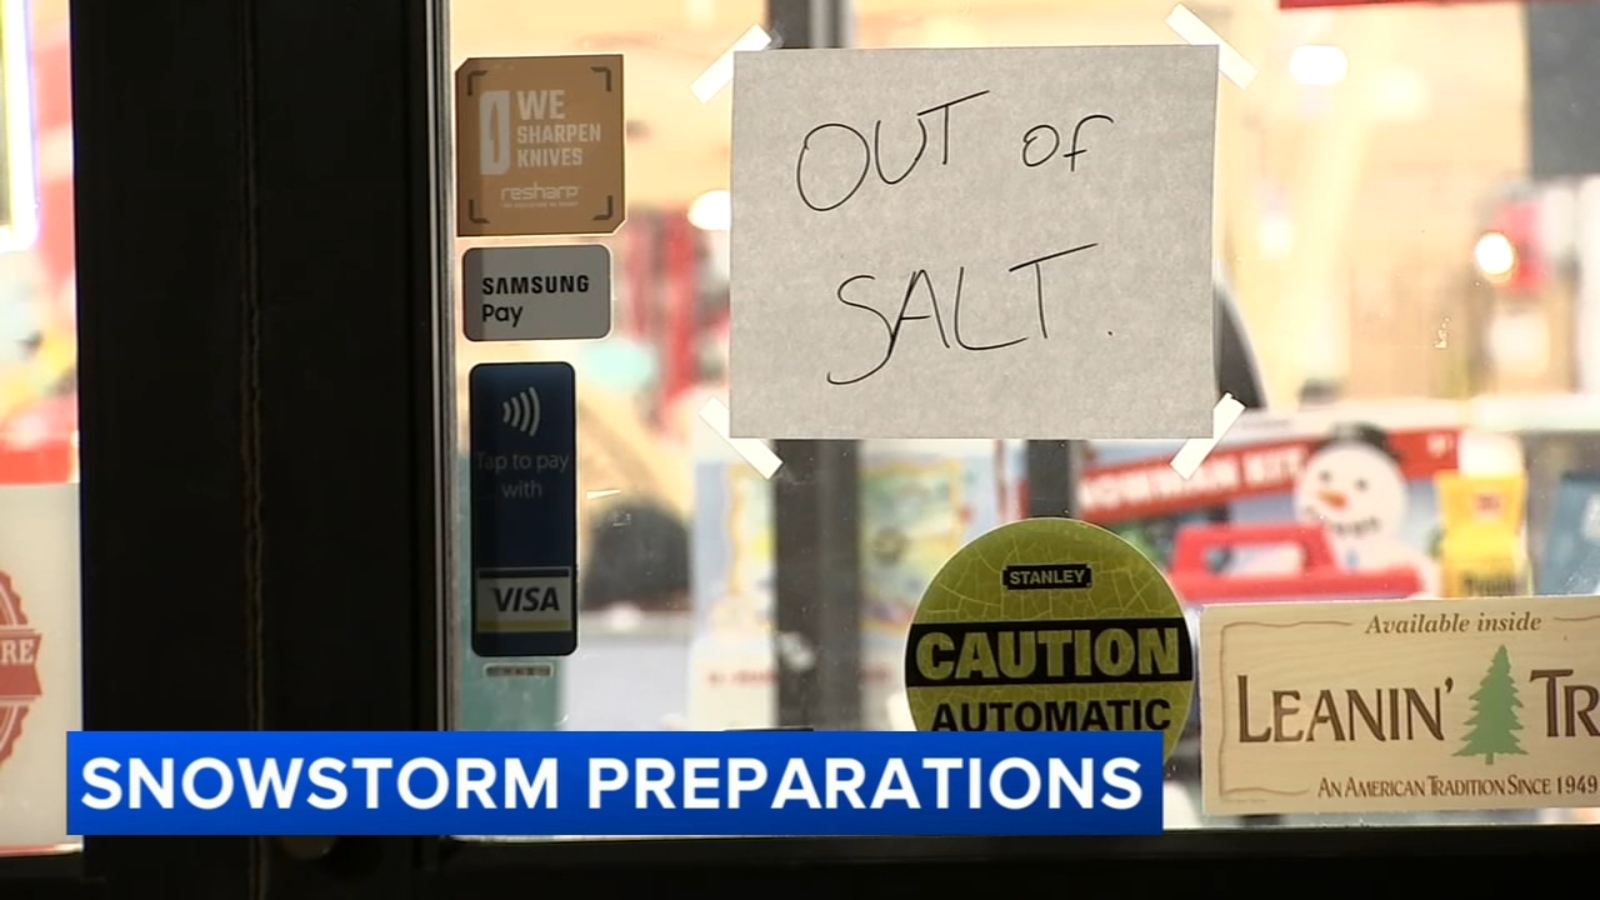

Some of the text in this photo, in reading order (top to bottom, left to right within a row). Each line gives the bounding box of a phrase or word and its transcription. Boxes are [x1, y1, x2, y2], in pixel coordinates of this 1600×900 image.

[516, 89, 566, 121] WE
[516, 124, 602, 145] SHARPEN
[516, 147, 584, 168] KNIVES
[797, 90, 990, 212] OUT
[501, 181, 580, 201] resharp
[481, 274, 590, 296] SAMSUNG
[481, 303, 524, 328] Pay
[475, 452, 569, 473] Tap to pay
[501, 479, 543, 499] with
[1009, 568, 1086, 586] STANLEY
[490, 586, 561, 613] VISA
[1365, 611, 1542, 635] Available inside
[915, 627, 1180, 681] CAUTION
[931, 698, 1172, 731] AUTOMATIC
[1345, 776, 1425, 798] AMERICAN
[1426, 774, 1507, 797] TRADITION
[1507, 773, 1552, 796] SINCE
[1556, 774, 1599, 795] 1949
